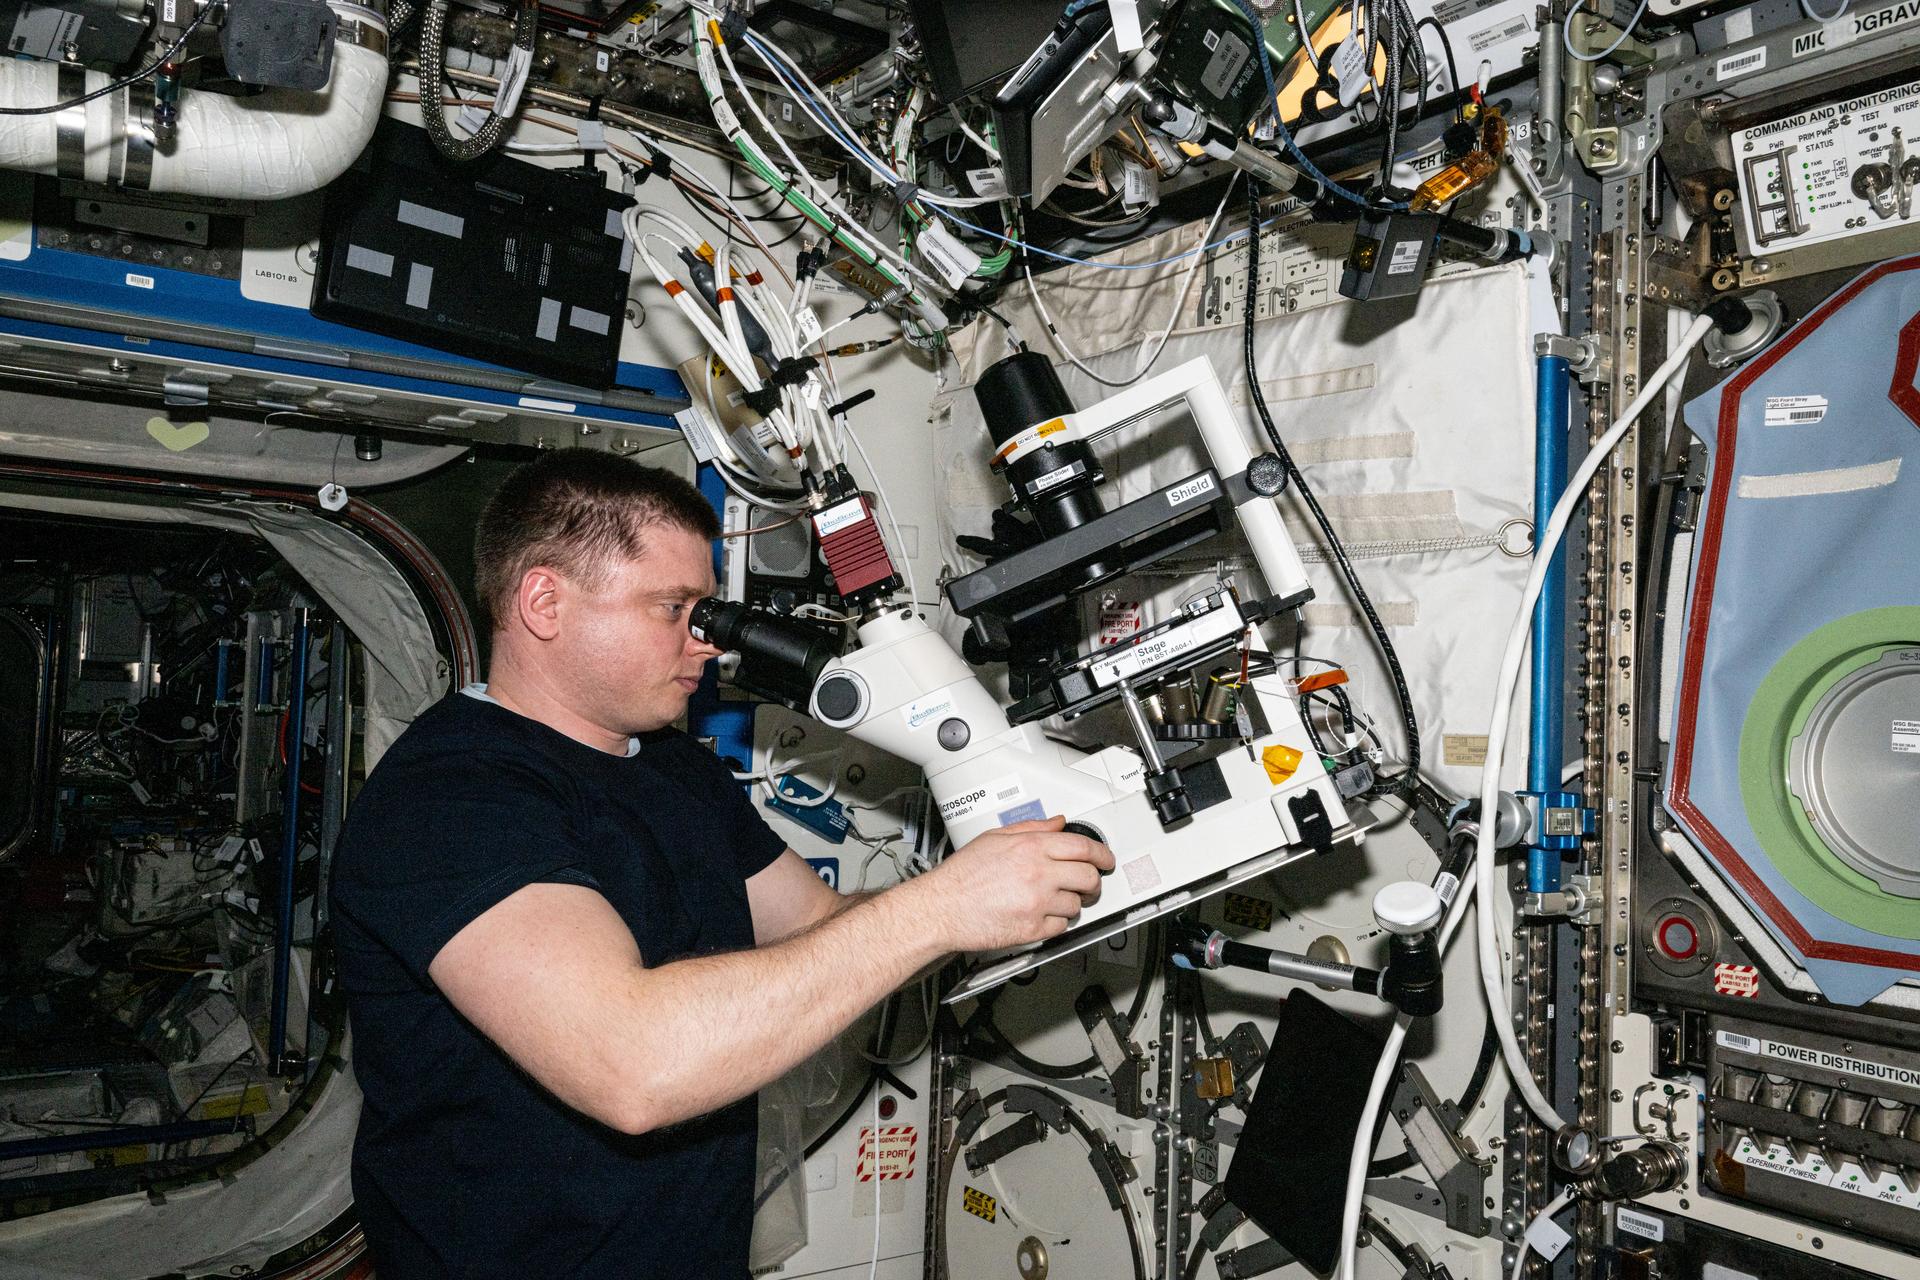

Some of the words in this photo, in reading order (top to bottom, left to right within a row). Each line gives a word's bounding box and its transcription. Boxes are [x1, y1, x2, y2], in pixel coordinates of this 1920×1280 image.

[166, 8, 174, 20] GSC
[1745, 115, 1806, 140] COMMAND
[1810, 107, 1835, 123] AND
[1839, 83, 1920, 114] MONITORING
[1861, 110, 1880, 122] TEST
[1519, 124, 1528, 138] 3
[1798, 132, 1815, 143] PRIM
[1816, 128, 1832, 138] PWR
[1768, 140, 1784, 150] PWR
[1806, 139, 1834, 152] STATUS
[1024, 434, 1034, 442] NOT
[1038, 474, 1054, 484] Phase
[1171, 478, 1210, 502] Shield
[1116, 620, 1134, 628] PORT
[1138, 638, 1166, 658] Stage
[1104, 652, 1133, 668] Movement
[1142, 656, 1154, 666] P/N
[1121, 769, 1139, 780] Turret
[1735, 974, 1750, 982] PORT
[1768, 1042, 1818, 1064] POWER
[1822, 1054, 1920, 1086] DISTRIBUTION
[866, 1150, 884, 1160] FIE
[886, 1150, 909, 1158] PORT
[1746, 1156, 1788, 1174] EXPERIMENT
[1788, 1166, 1818, 1181] POWERS
[1840, 1181, 1857, 1190] FAN
[1879, 1192, 1896, 1202] FAN
